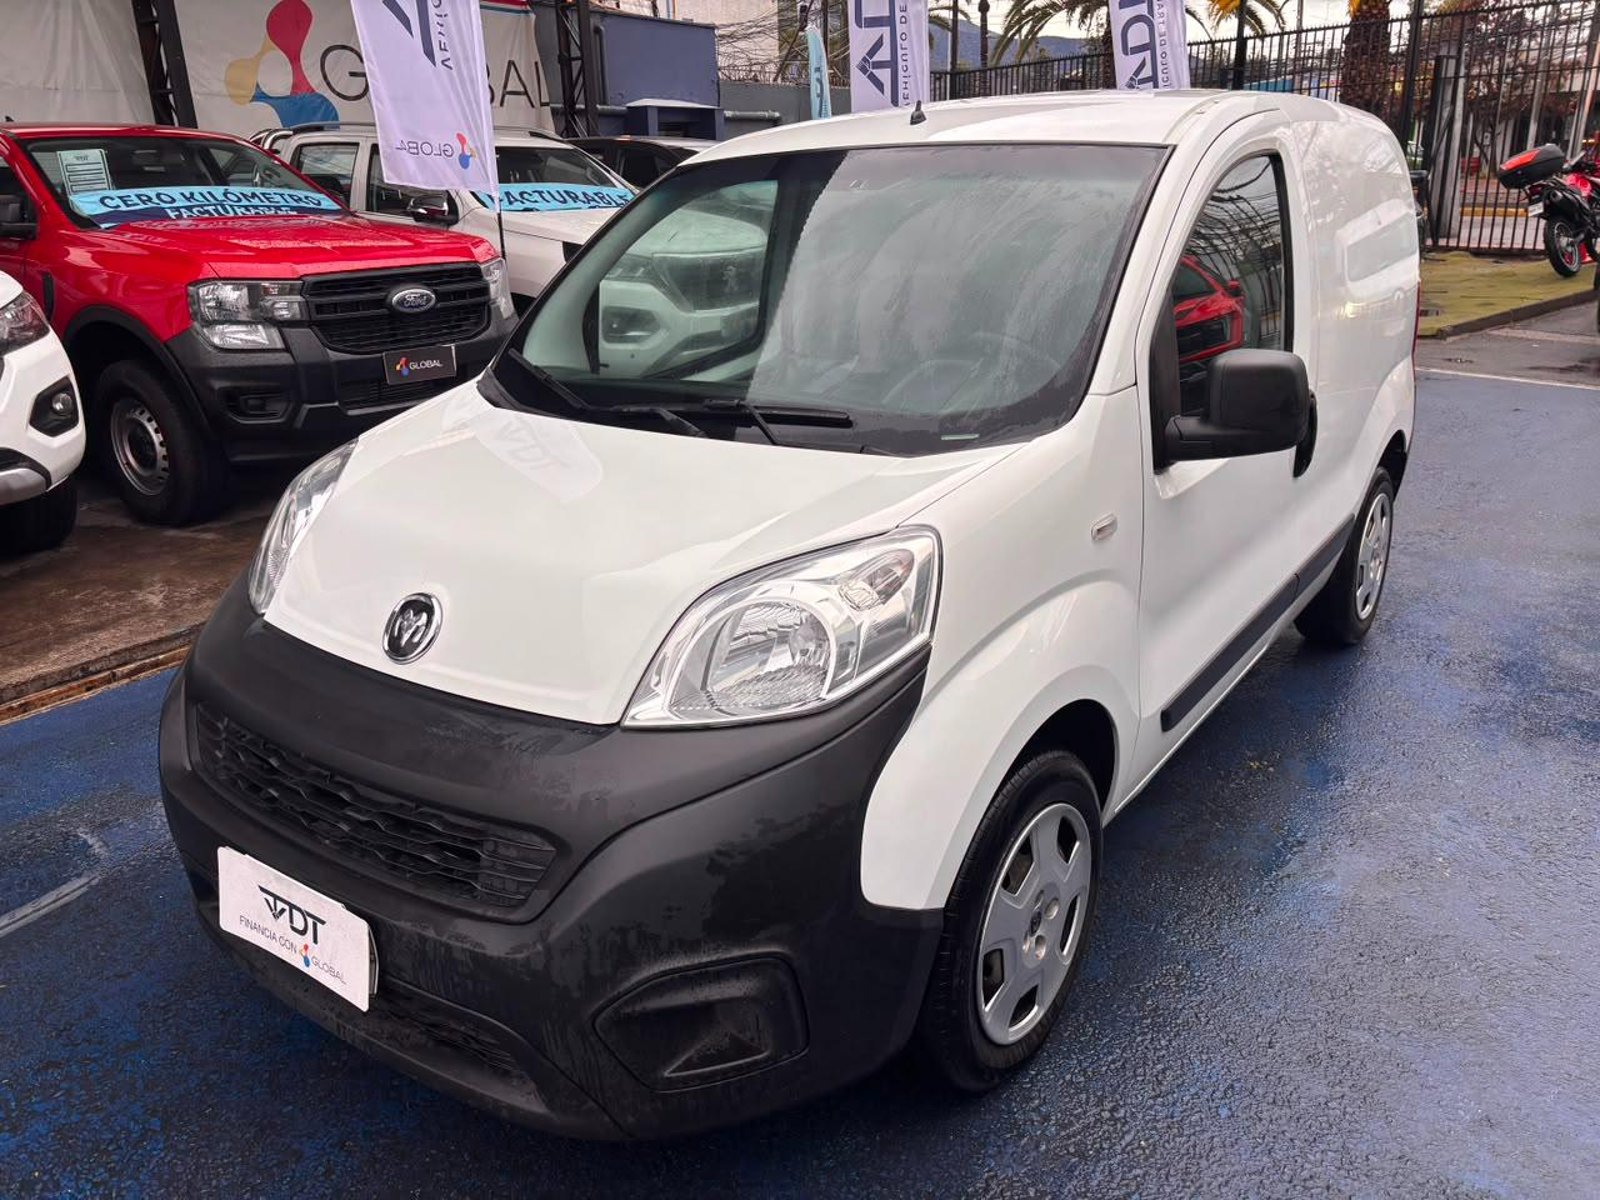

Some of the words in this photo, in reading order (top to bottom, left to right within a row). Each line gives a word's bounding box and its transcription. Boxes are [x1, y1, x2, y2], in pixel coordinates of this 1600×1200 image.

[99, 191, 177, 209] CERO
[181, 189, 321, 207] KILÓMETRO
[408, 359, 444, 370] GLOBAL
[257, 885, 327, 945] VDT
[238, 914, 278, 943] FINANCIA
[278, 935, 298, 954] CON
[310, 955, 348, 985] GLOBAL
